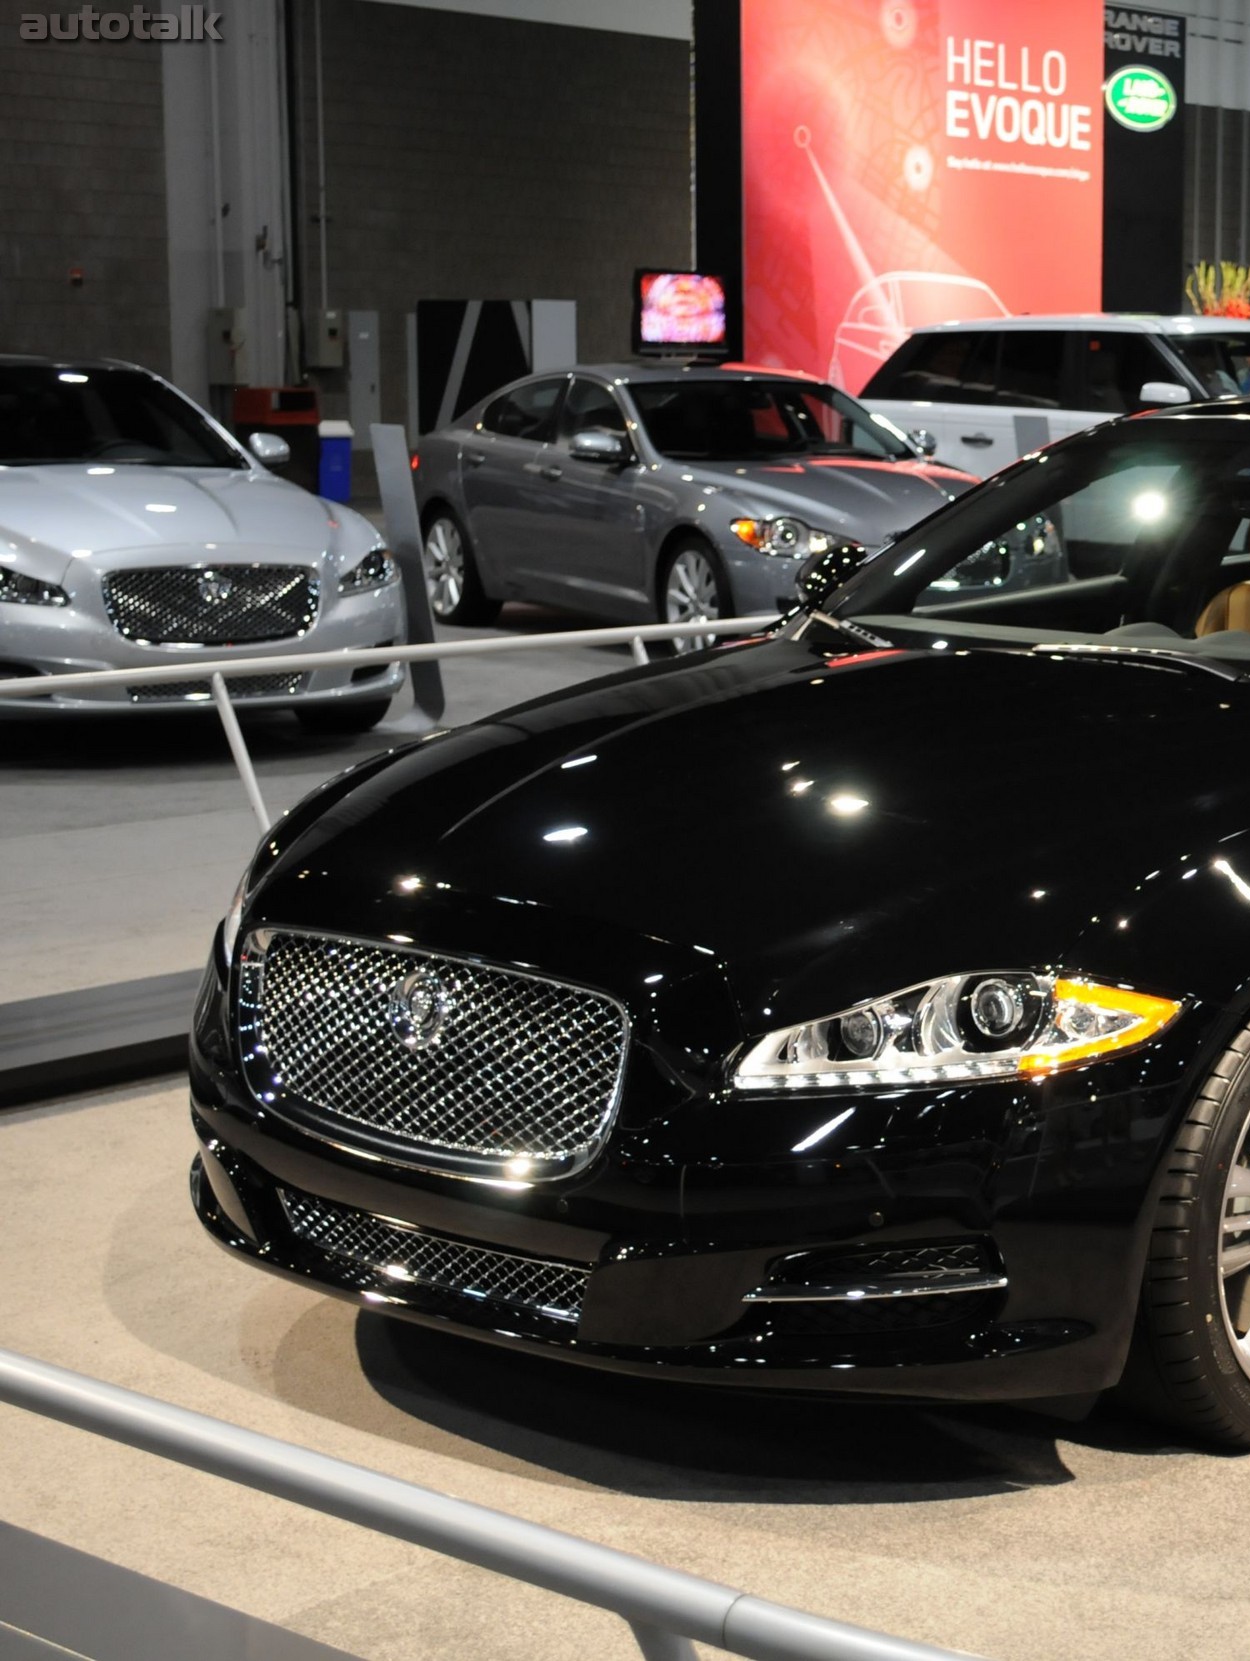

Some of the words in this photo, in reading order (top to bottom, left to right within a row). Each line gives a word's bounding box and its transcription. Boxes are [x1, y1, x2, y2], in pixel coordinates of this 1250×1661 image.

[1104, 9, 1179, 37] RANGE
[1104, 31, 1181, 58] ROVER
[947, 36, 1067, 96] HELLO
[946, 89, 1091, 151] EVOQUE
